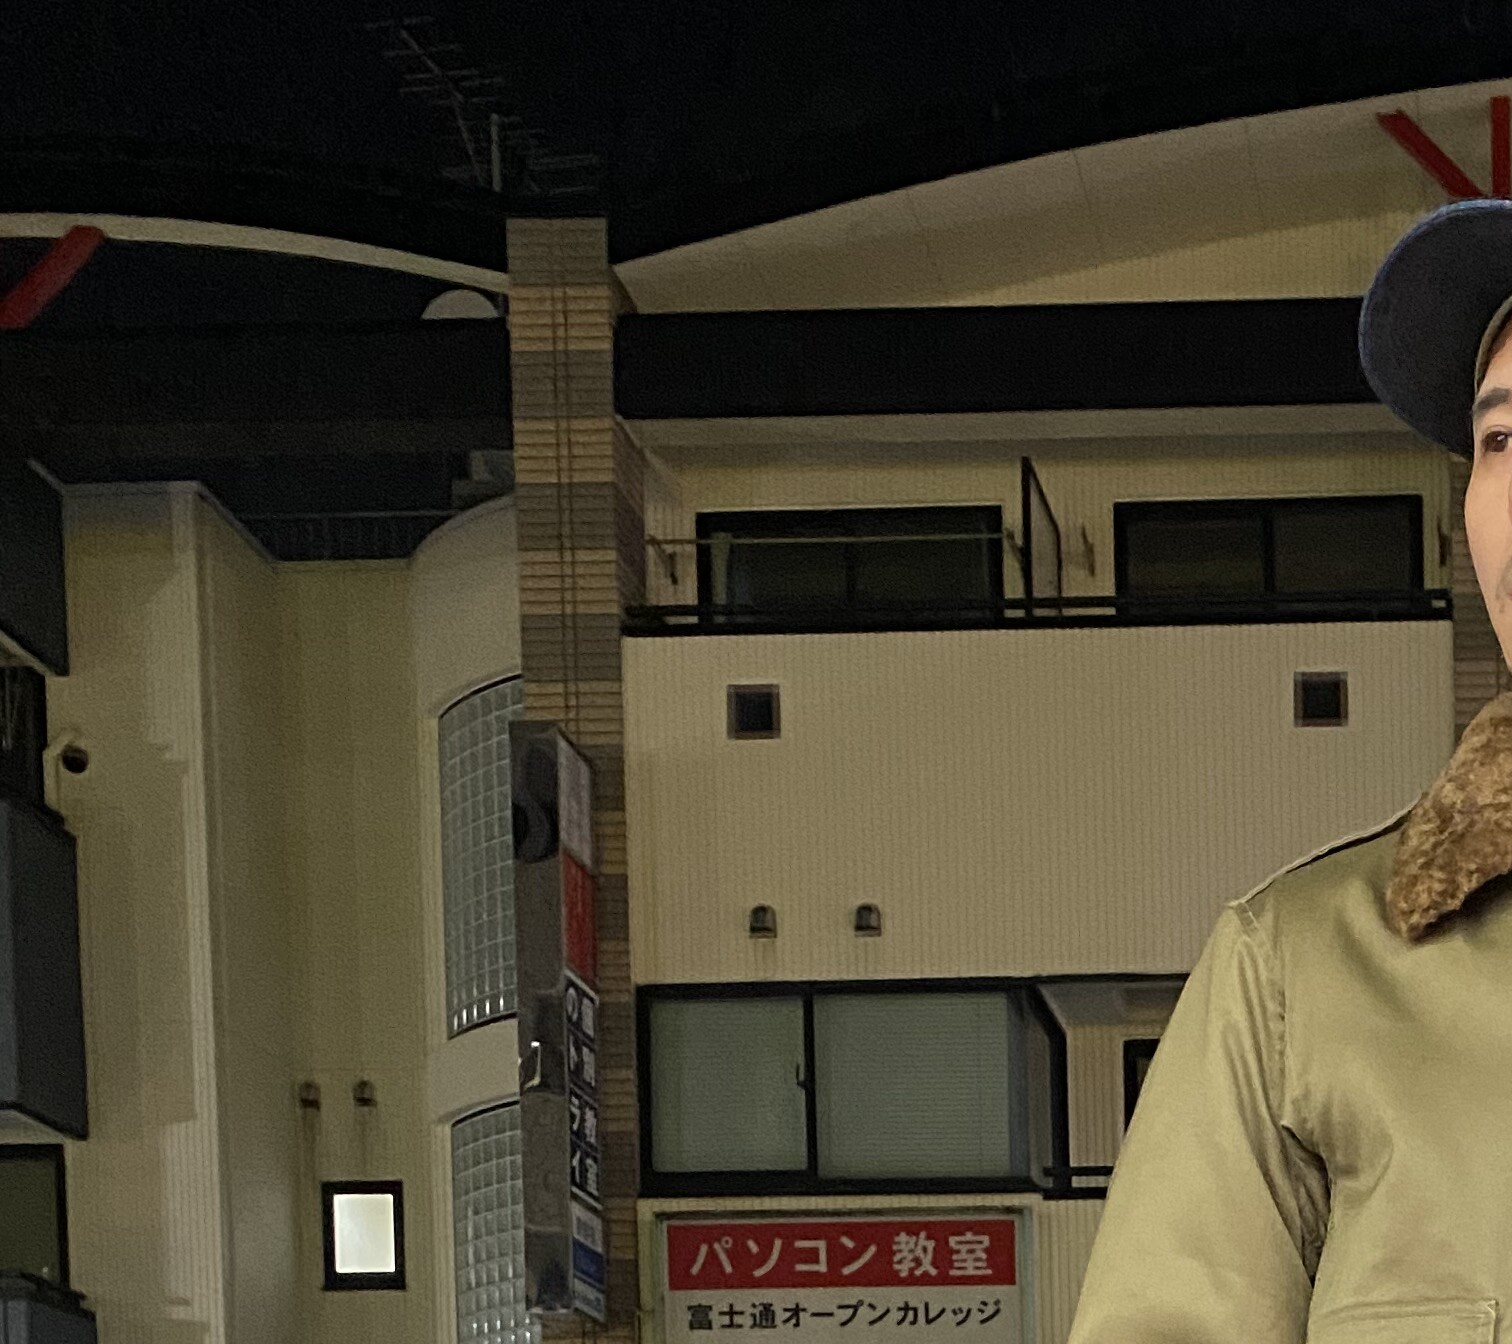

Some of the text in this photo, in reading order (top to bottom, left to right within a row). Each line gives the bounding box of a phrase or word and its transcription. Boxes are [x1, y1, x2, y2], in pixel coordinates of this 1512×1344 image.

[690, 1231, 993, 1278] パソコン教室
[687, 1299, 1002, 1332] 富士通オープンカレッジ
